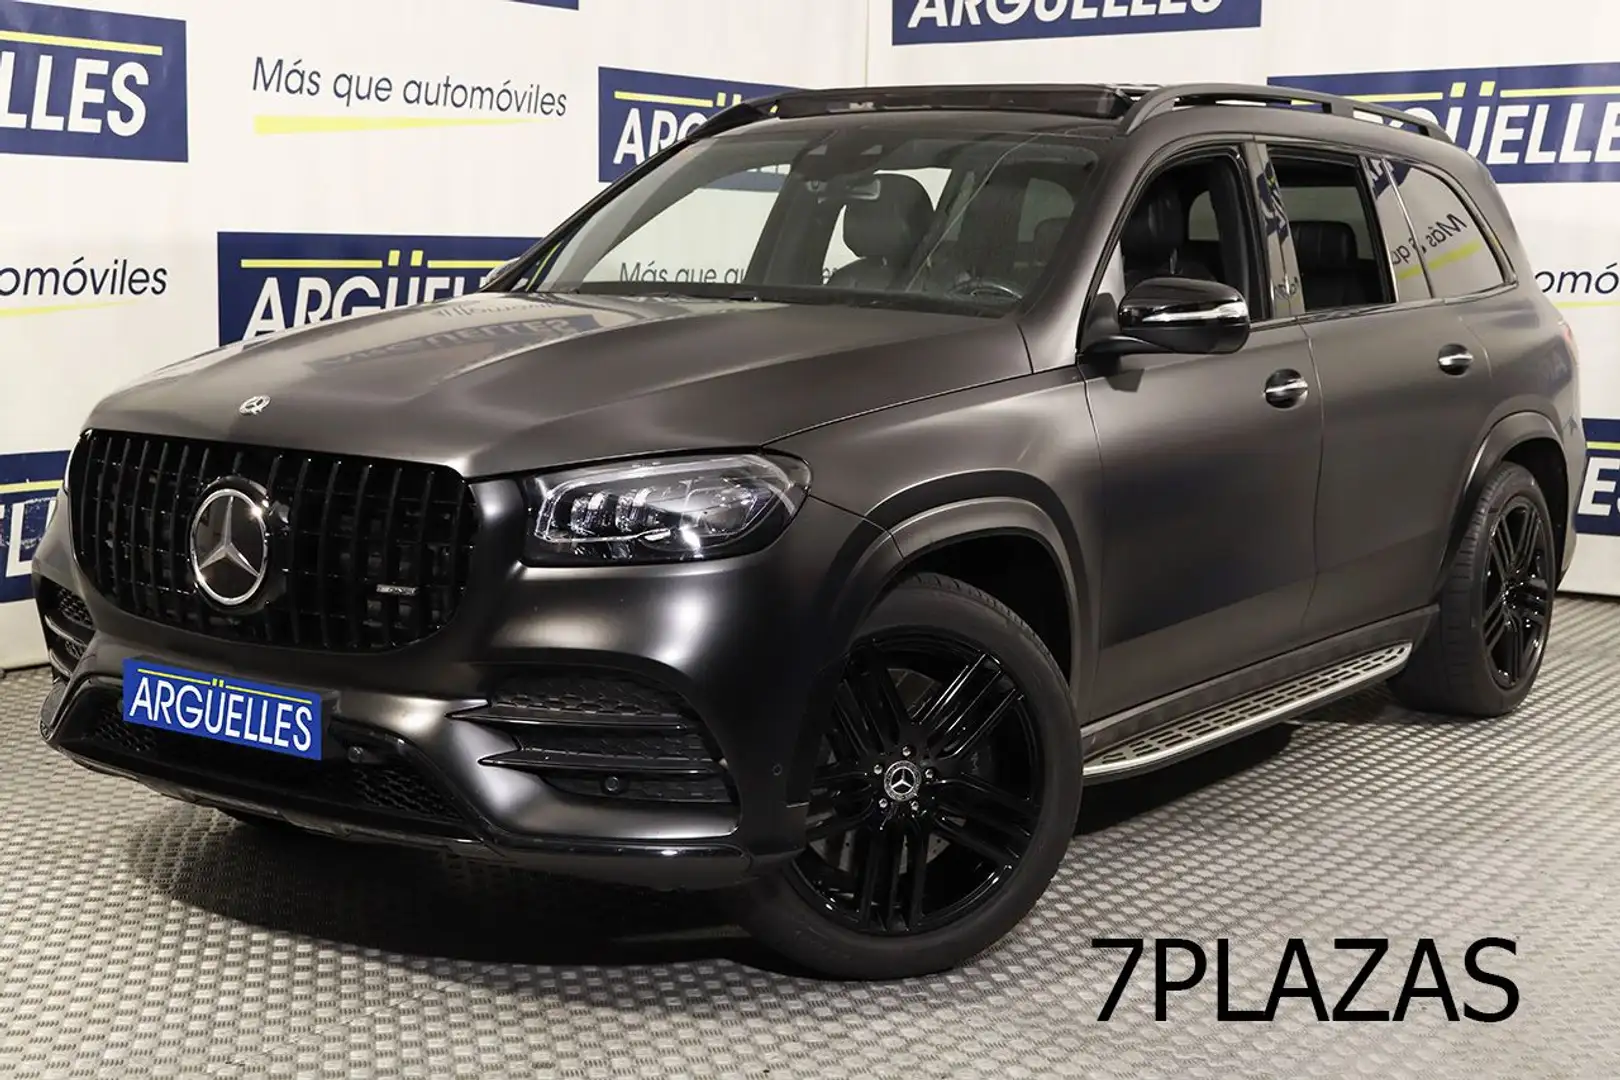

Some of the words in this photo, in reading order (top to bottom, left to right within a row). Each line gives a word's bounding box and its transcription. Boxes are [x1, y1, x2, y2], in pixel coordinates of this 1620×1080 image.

[0, 51, 149, 137] LLES
[252, 57, 321, 96] Más
[333, 72, 393, 107] que
[403, 76, 567, 117] automóviles
[0, 256, 168, 296] omóviles
[129, 677, 313, 752] ARGÜELLES
